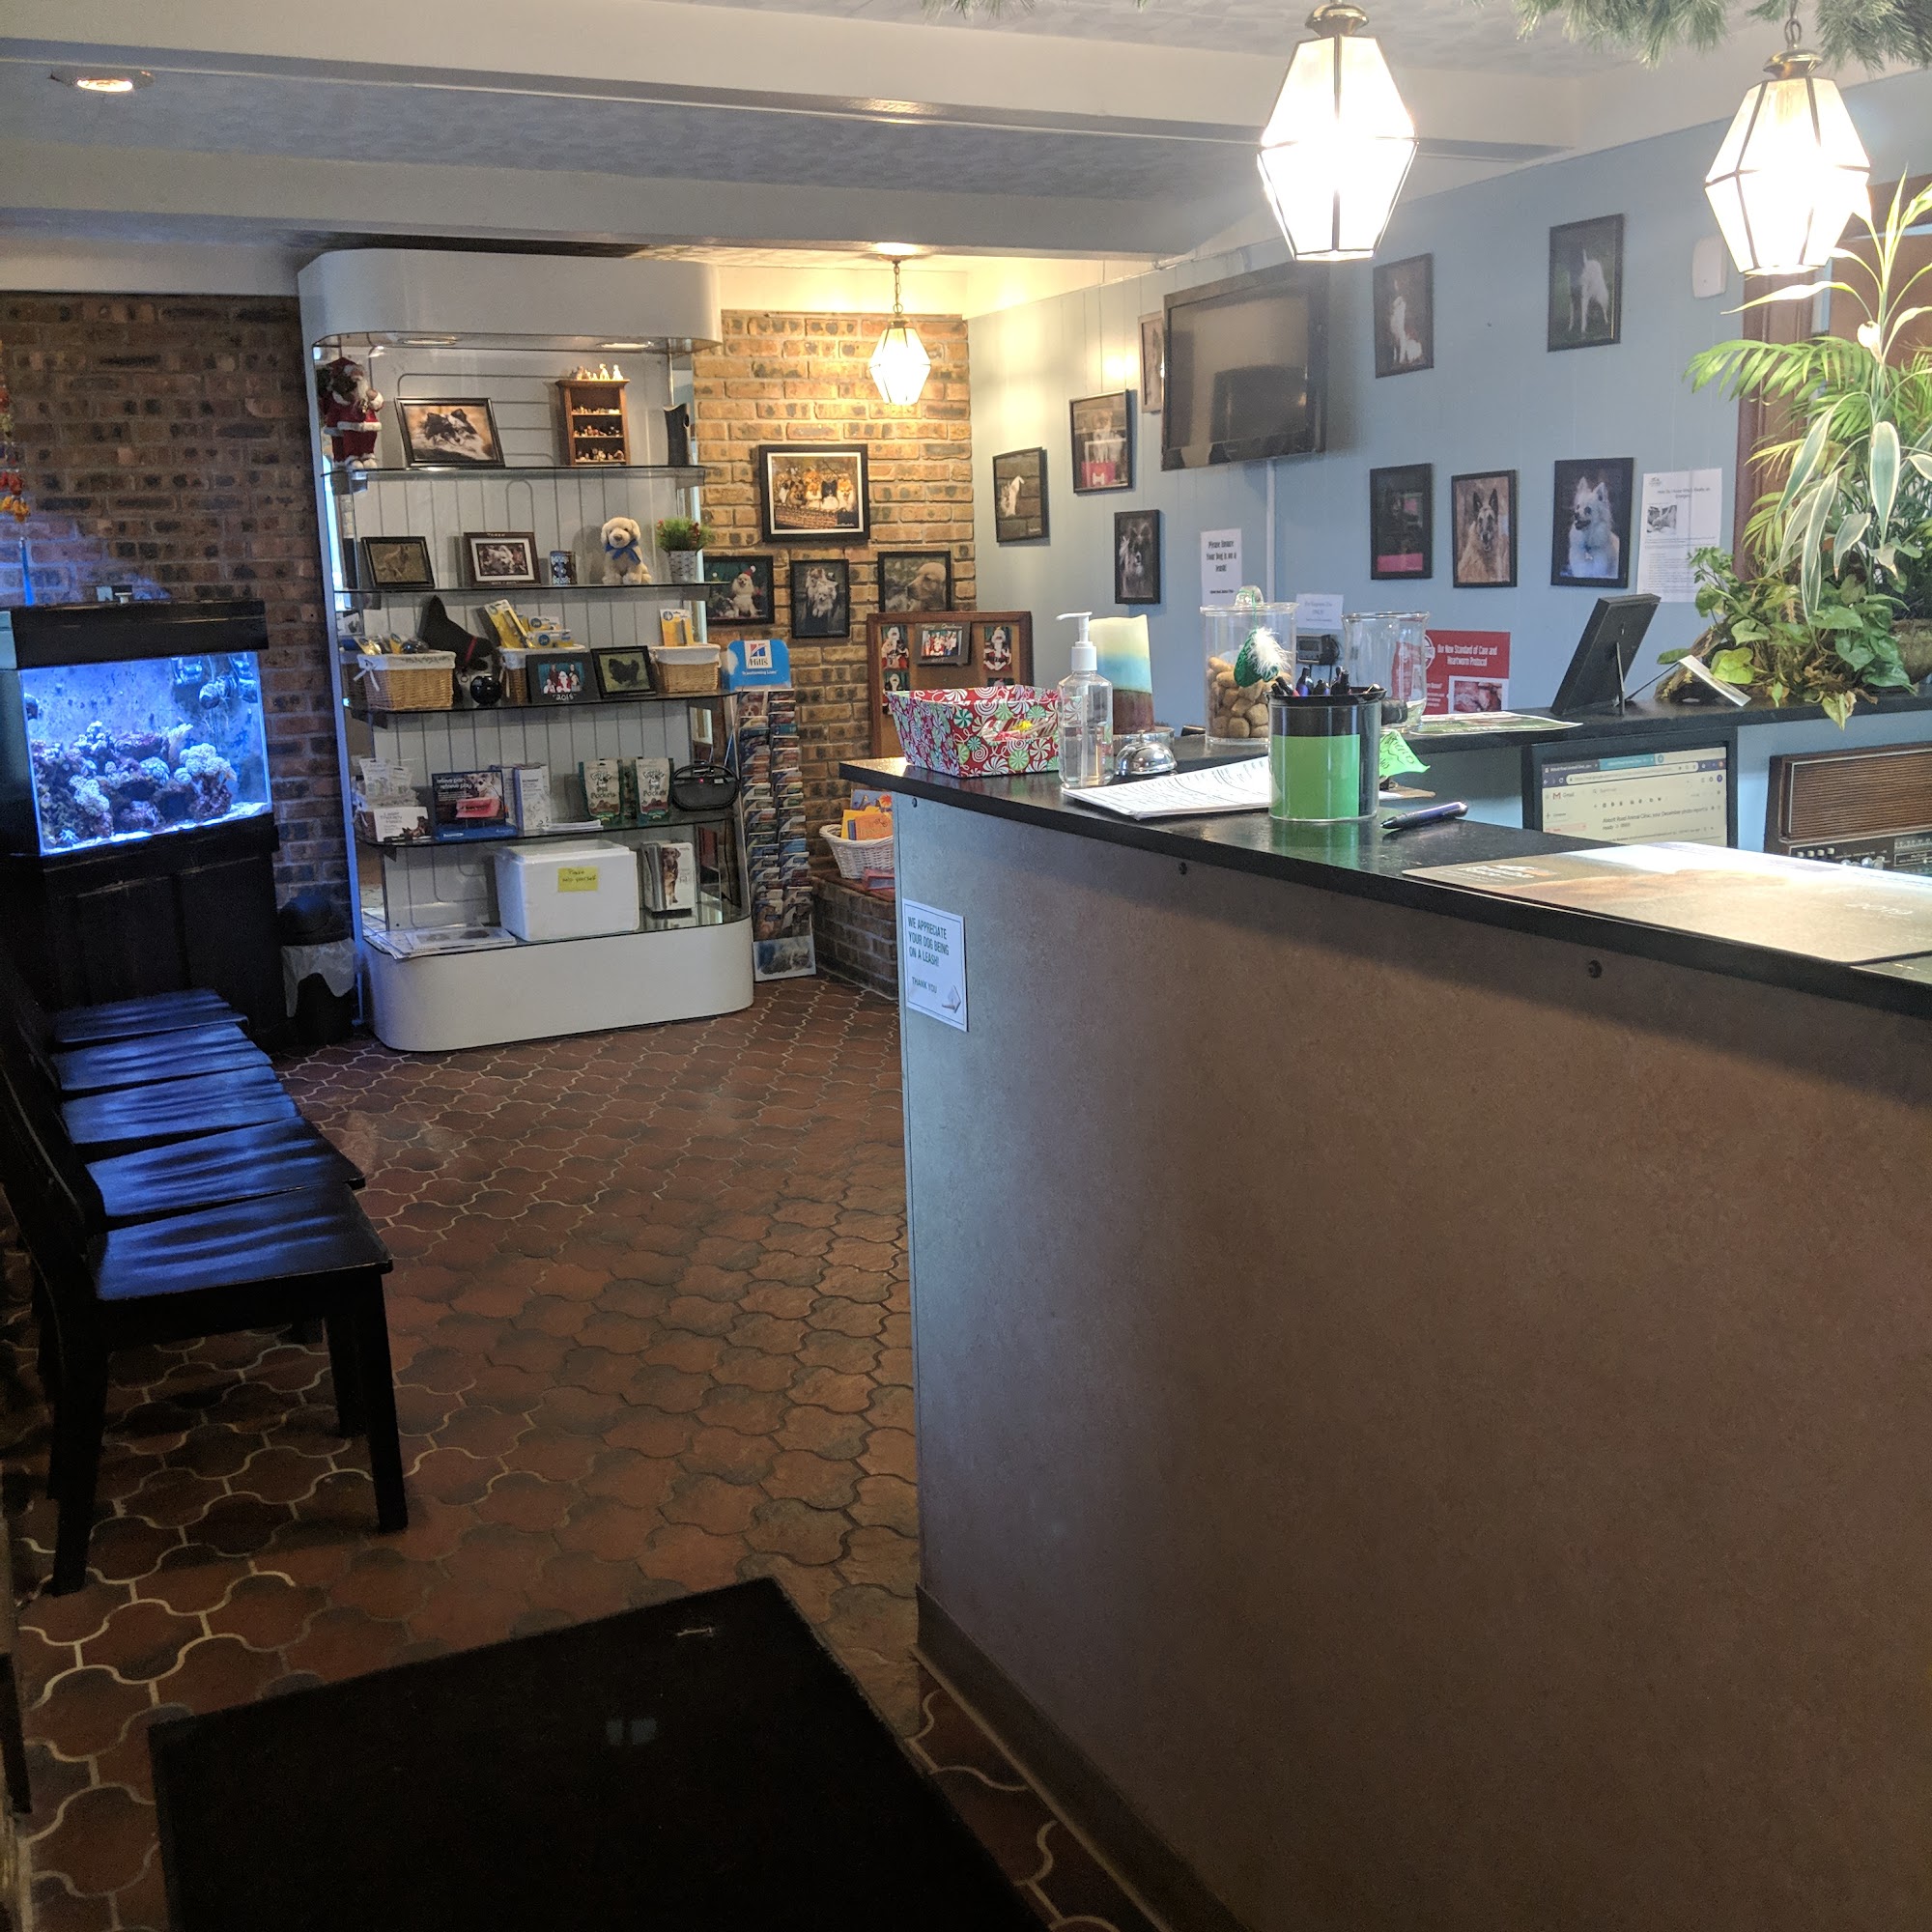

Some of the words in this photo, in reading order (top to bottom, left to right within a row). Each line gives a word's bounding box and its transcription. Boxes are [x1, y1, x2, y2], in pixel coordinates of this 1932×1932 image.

[1215, 552, 1224, 560] Dog
[1436, 644, 1445, 654] Our
[1454, 644, 1473, 655] Standard
[1479, 646, 1489, 655] Care
[1489, 646, 1498, 656] and
[750, 658, 769, 667] Hill's
[908, 916, 917, 928] WE
[917, 918, 948, 940] APPRECIATE
[908, 930, 923, 946] YOUR
[923, 937, 934, 951] DOG
[933, 939, 950, 956] BEING
[909, 946, 917, 958] ON
[917, 949, 923, 960] A
[923, 950, 940, 967] LEASH!
[911, 976, 927, 990] THANK
[927, 982, 938, 994] YOU
